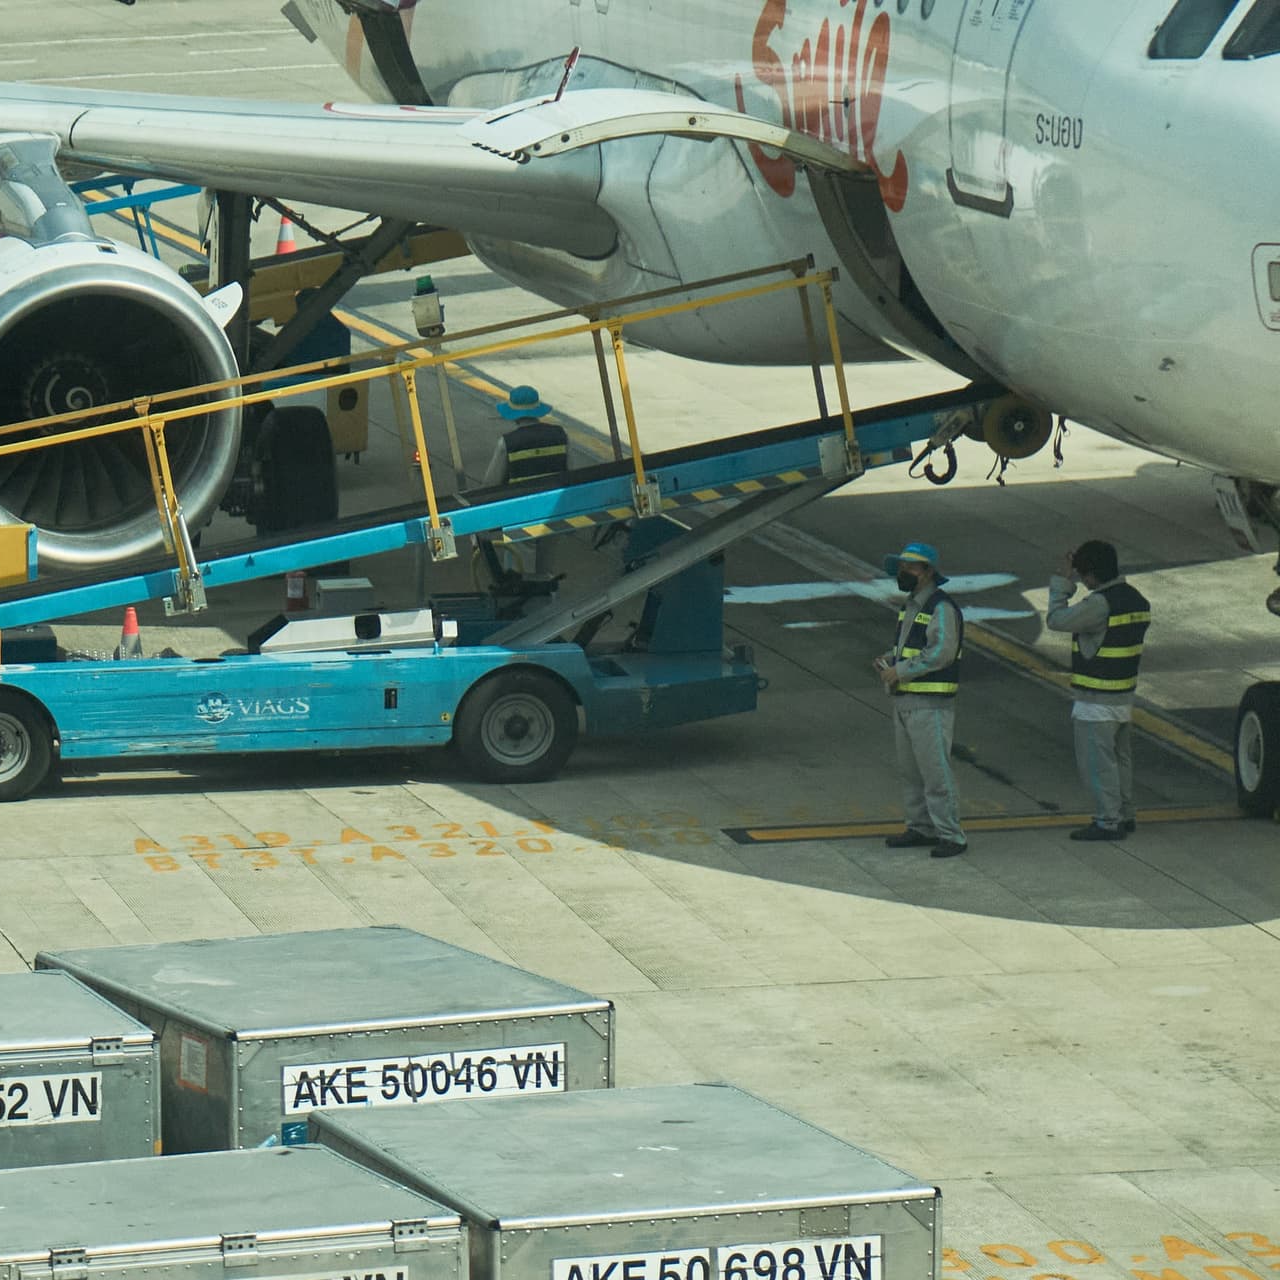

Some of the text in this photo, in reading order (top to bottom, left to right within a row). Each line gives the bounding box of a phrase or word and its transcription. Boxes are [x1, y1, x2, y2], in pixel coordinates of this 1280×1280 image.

[237, 697, 310, 715] VIAGS
[43, 1077, 98, 1117] VN
[293, 1051, 559, 1108] AKE 50046 VN
